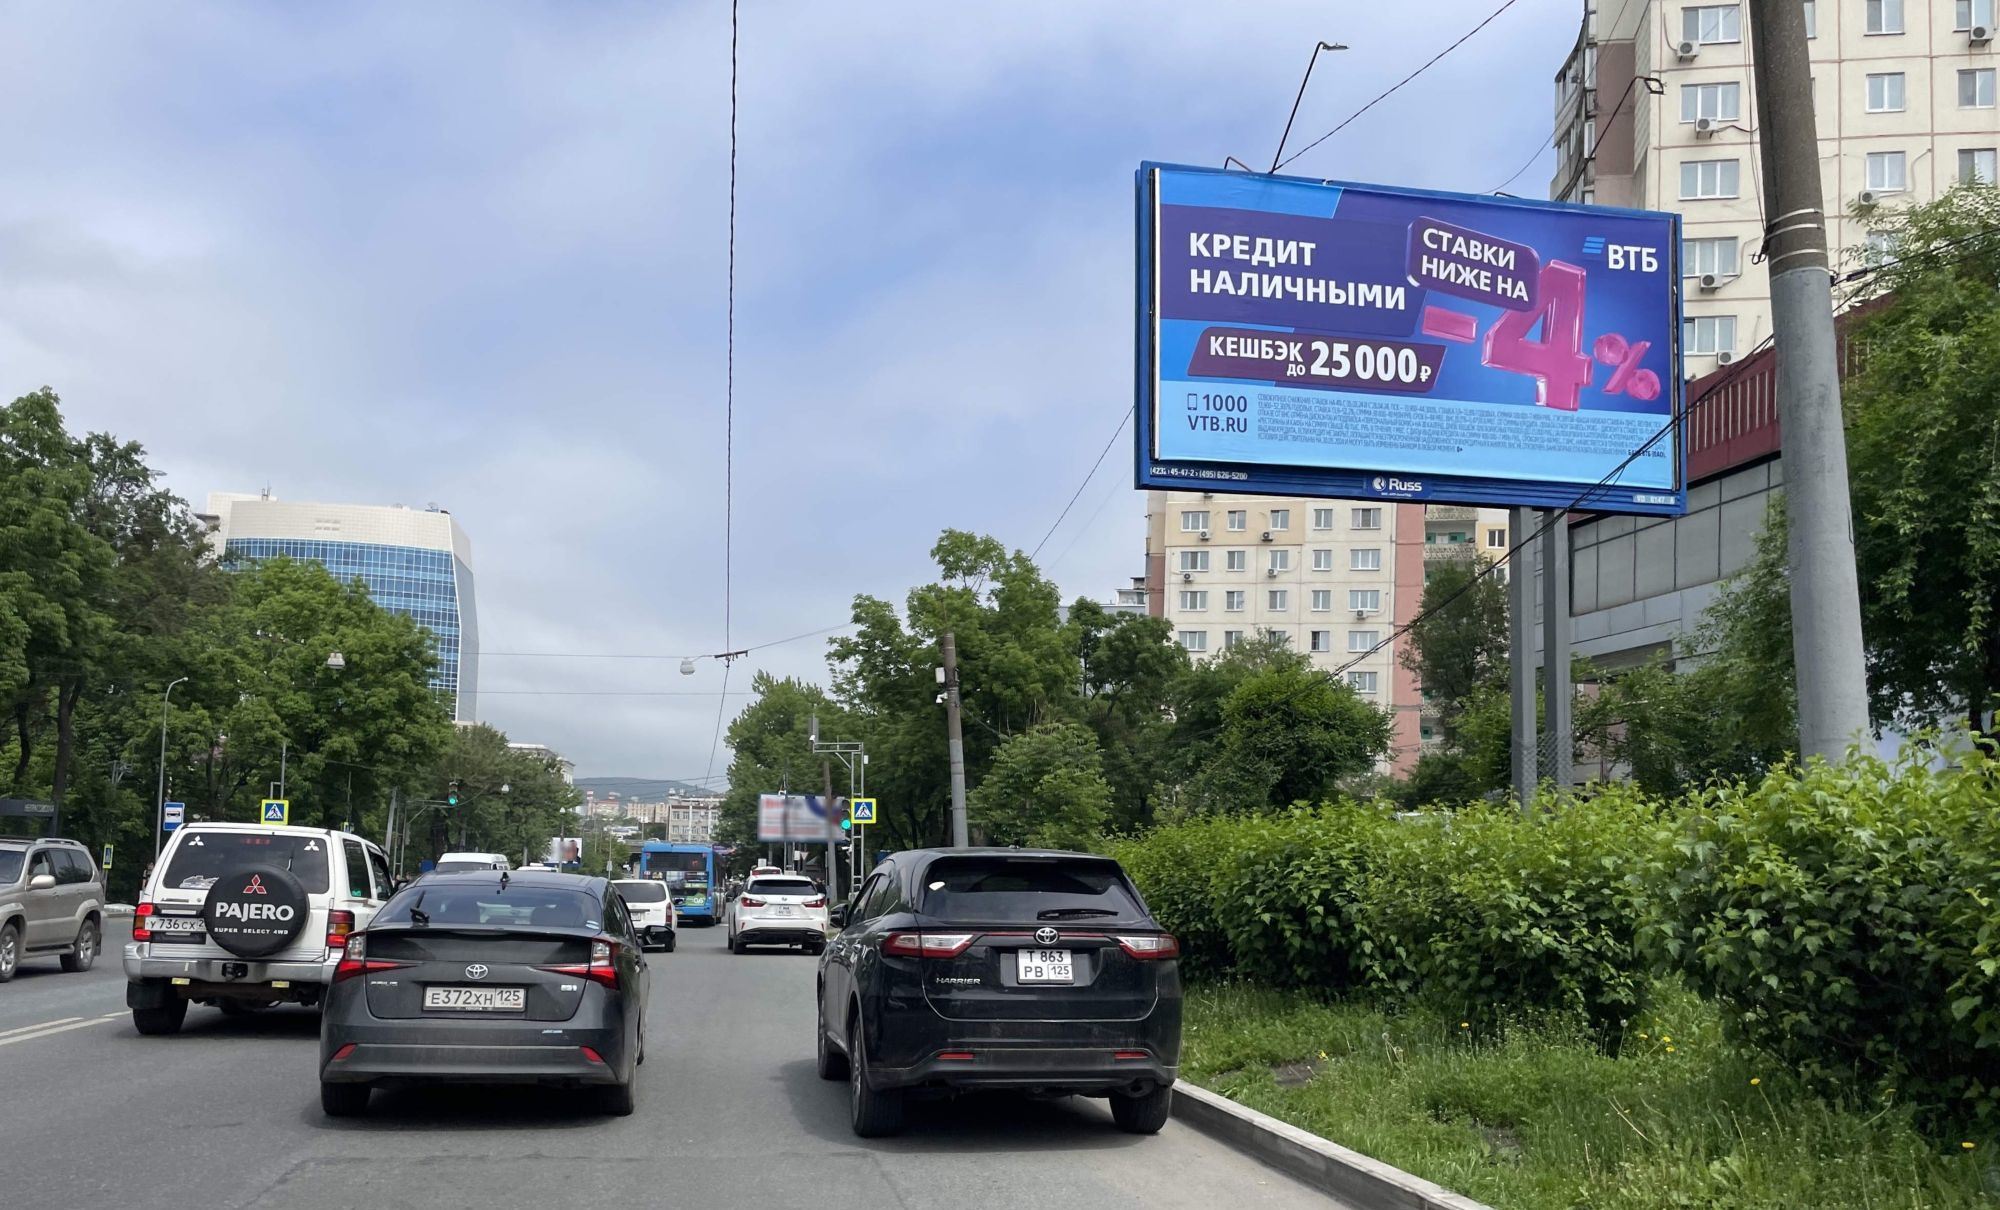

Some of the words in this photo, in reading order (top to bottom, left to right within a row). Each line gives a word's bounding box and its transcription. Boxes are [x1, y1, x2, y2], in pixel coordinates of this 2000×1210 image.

[1189, 232, 1316, 267] КРЕДИТ
[1422, 228, 1516, 271] СТАВКИ
[1607, 244, 1659, 272] ВТБ
[1189, 269, 1406, 310] НАЛИЧНЫМИ
[1421, 255, 1491, 292] НИЖЕ
[1496, 275, 1529, 302] НА
[1210, 336, 1304, 362] КЕШБЭК
[1202, 394, 1248, 412] 1000
[1187, 415, 1248, 433] VTB.RU
[1389, 478, 1423, 492] Russ
[215, 902, 294, 922] PAJERO
[936, 977, 981, 985] HARRIER
[496, 989, 520, 1002] 125
